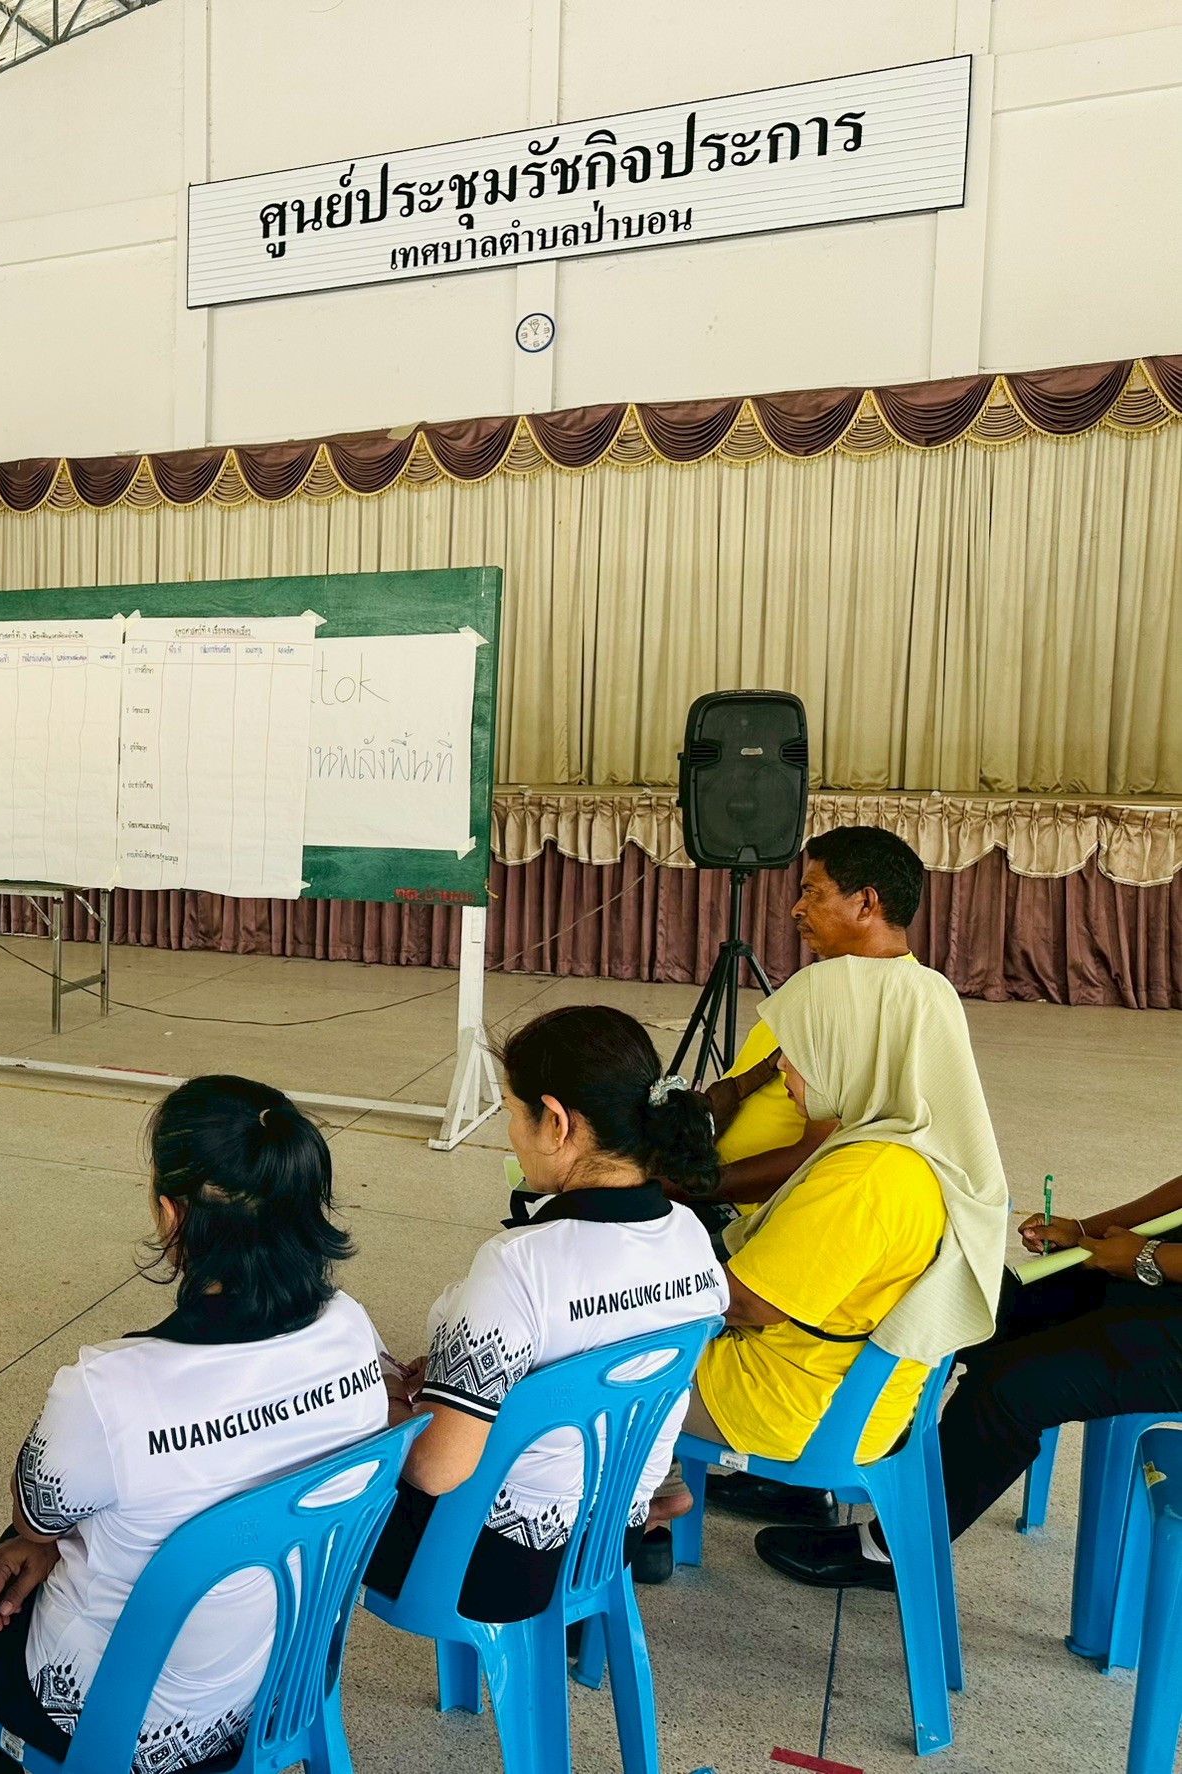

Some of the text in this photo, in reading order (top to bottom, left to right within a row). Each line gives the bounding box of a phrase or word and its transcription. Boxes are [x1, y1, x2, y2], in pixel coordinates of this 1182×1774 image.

[259, 111, 867, 259] ศูนย์ประชุมรัชกิจประการ
[389, 200, 693, 270] เทศบาลตำบลป่าบอน
[569, 1283, 661, 1322] MUANGLUNG
[665, 1276, 692, 1300] LINE
[148, 1359, 381, 1455] MUANGLUNG LINE DANCE
